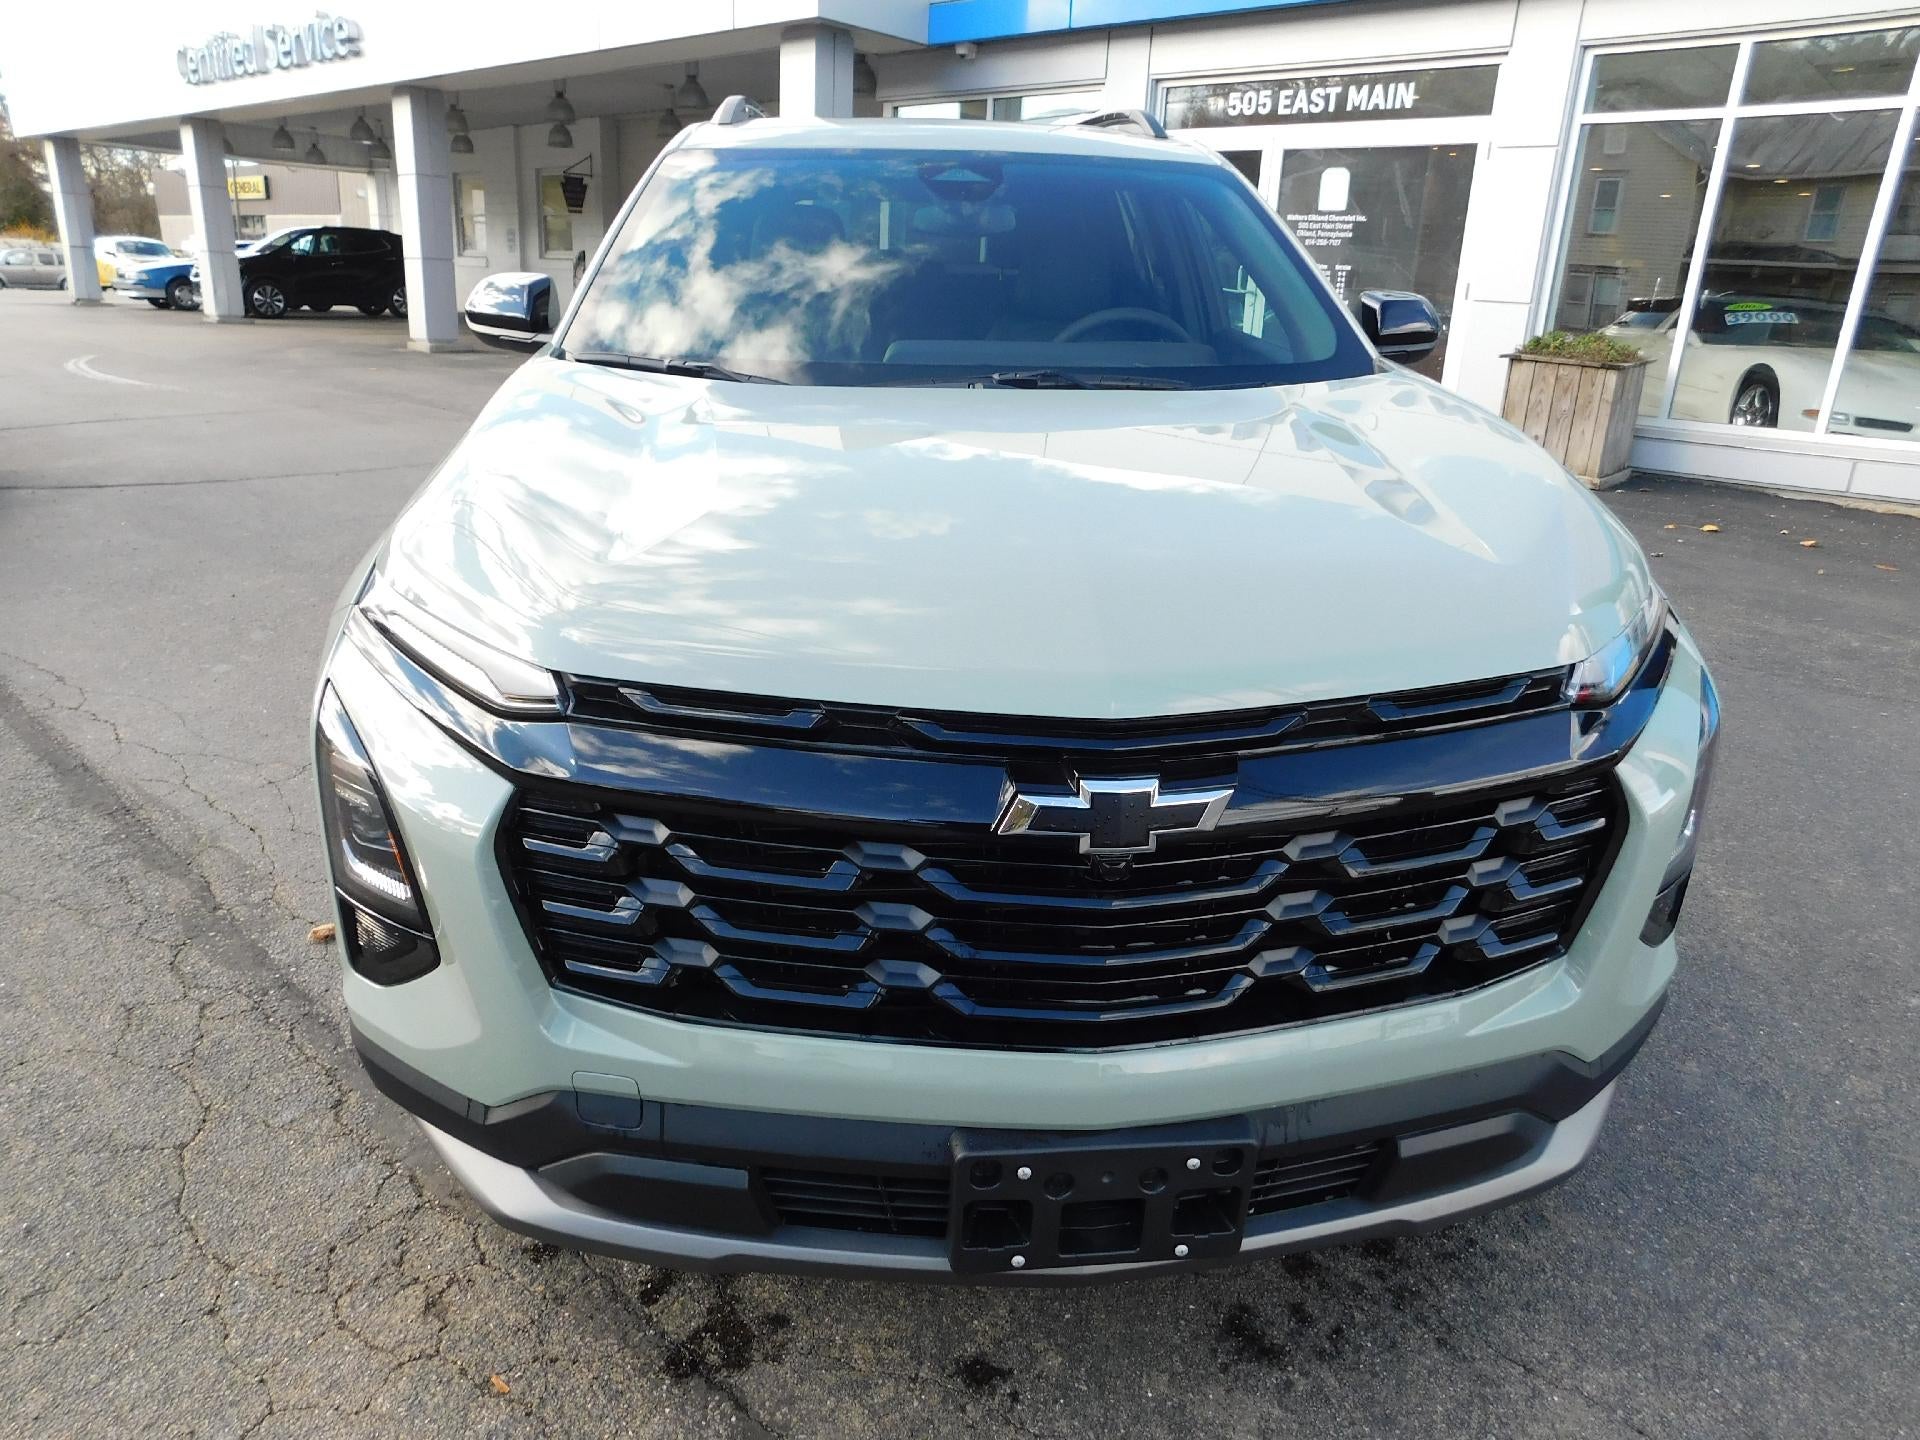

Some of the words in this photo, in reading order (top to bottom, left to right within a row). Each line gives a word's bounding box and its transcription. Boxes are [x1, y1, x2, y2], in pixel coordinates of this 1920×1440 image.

[176, 28, 258, 84] Certified
[259, 10, 364, 73] Service
[1228, 91, 1273, 117] 505
[1277, 86, 1342, 115] EAST
[1346, 81, 1416, 112] MAIN
[1328, 214, 1356, 222] Chevrolet
[1335, 222, 1354, 230] Street
